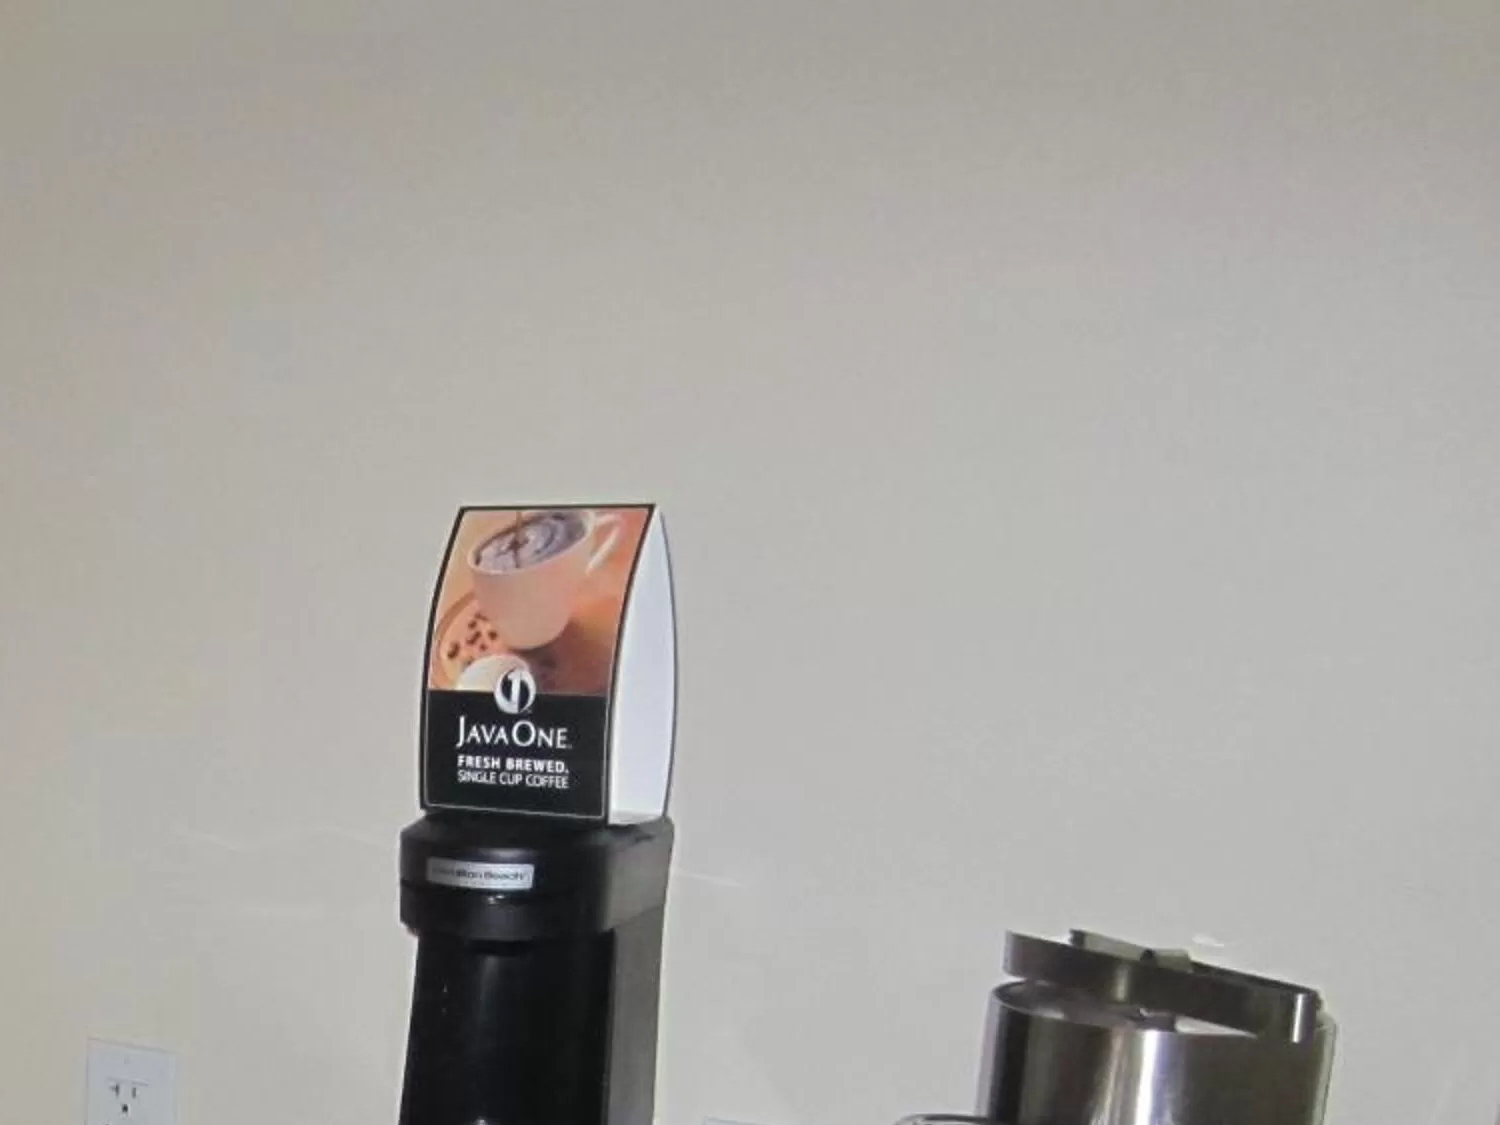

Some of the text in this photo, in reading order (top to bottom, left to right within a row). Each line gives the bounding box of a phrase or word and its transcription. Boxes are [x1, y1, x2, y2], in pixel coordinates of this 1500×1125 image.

[457, 755, 501, 769] FRESH
[458, 769, 570, 789] SINGLE CUP COFFEE
